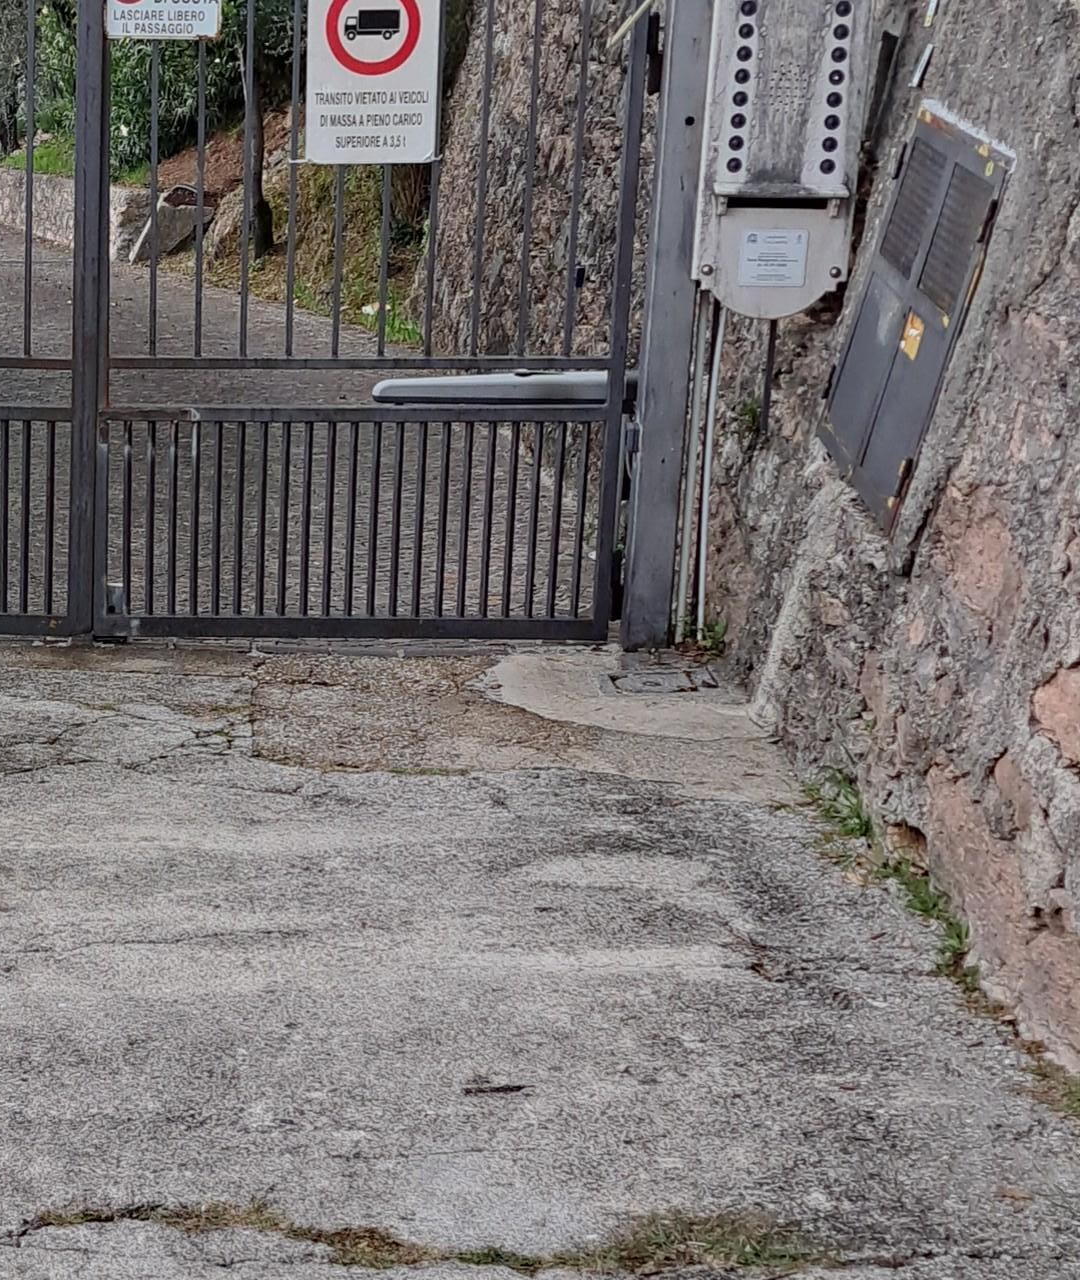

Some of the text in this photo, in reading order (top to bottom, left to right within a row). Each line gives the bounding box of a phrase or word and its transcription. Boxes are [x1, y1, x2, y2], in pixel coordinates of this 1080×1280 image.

[113, 9, 205, 22] LASCIARE LIBERO
[122, 23, 194, 34] IL PASSAGGIO
[314, 90, 429, 105] TRANSITO VIETATO AI VEICOLI
[320, 112, 423, 127] DI MASSA A PIENO CARICO
[335, 136, 381, 148] SUPERIORE
[382, 135, 388, 147] A
[390, 135, 401, 149] 3,5
